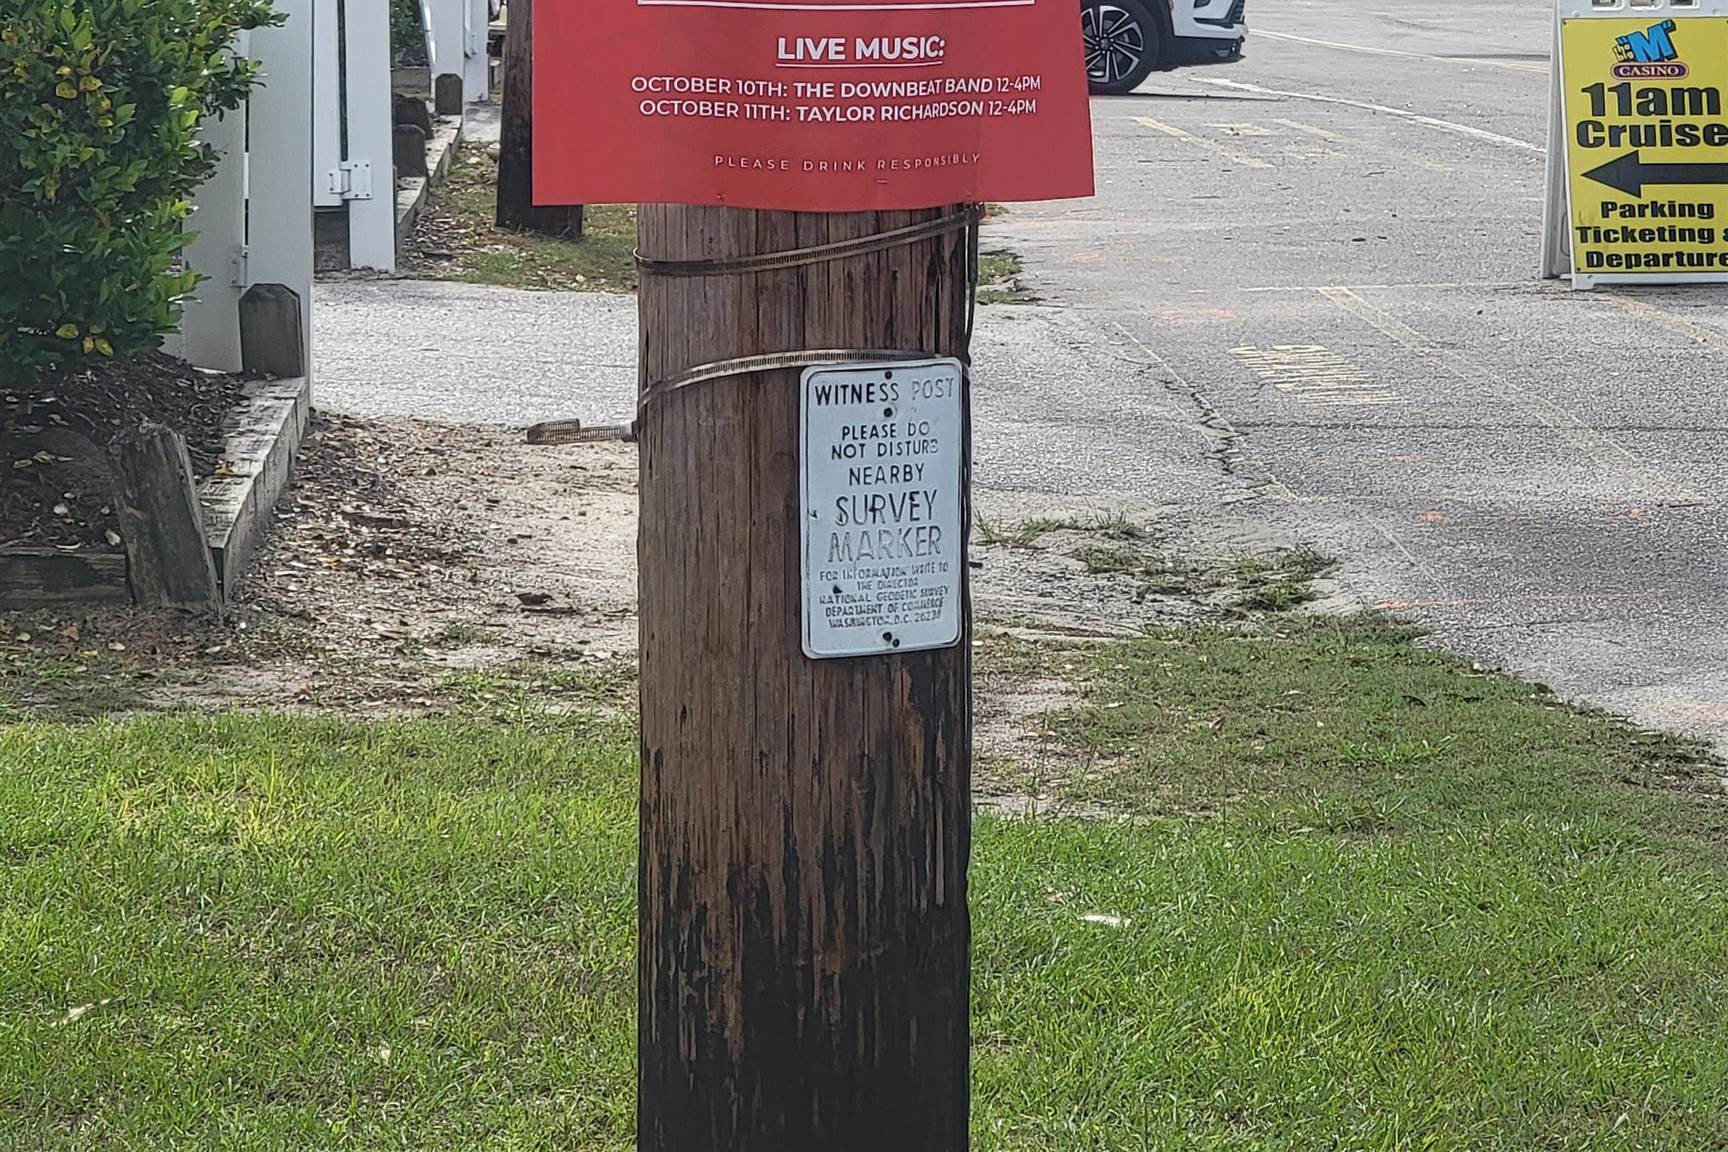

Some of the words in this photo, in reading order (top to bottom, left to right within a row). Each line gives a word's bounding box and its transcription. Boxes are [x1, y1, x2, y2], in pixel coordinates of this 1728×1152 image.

[777, 37, 846, 61] LIVE
[855, 35, 946, 60] MUSIC:
[1619, 66, 1680, 77] CASINO
[631, 76, 731, 94] OCTOBER
[736, 79, 788, 97] 10TH:
[793, 82, 835, 98] THE
[841, 79, 943, 98] DOWNBEAT
[945, 77, 993, 94] BAND
[996, 75, 1041, 93] 12-4PM
[1581, 81, 1721, 117] 11am
[639, 99, 739, 118] OCTOBER
[743, 103, 791, 121] 11TH:
[795, 105, 875, 122] TAYLOR
[881, 100, 984, 121] RICHARDSON
[988, 99, 1036, 116] 12-4PM
[1576, 119, 1728, 148] Cruise
[715, 155, 789, 170] PLEASE
[803, 159, 866, 172] DRINK
[877, 153, 981, 171] RESPONSIBLY
[1601, 200, 1714, 220] Parking
[1575, 225, 1715, 244] Ticketing
[815, 382, 900, 406] WITNESS
[912, 378, 954, 400] POST
[842, 422, 897, 441] PLEASE
[907, 421, 930, 437] DO
[831, 443, 866, 460] NOT
[877, 439, 939, 458] DISTURB
[849, 462, 925, 486] NEARBY
[835, 489, 937, 527] SURVEY
[828, 525, 942, 563] MARKER
[819, 570, 838, 581] FOR
[938, 561, 949, 573] TO
[819, 593, 872, 605] NATIONAL
[876, 588, 917, 602] GEODETIC
[920, 585, 949, 598] SURVEY
[857, 580, 873, 591] THE
[825, 603, 883, 617] DEPARTMENT
[888, 603, 899, 614] OF
